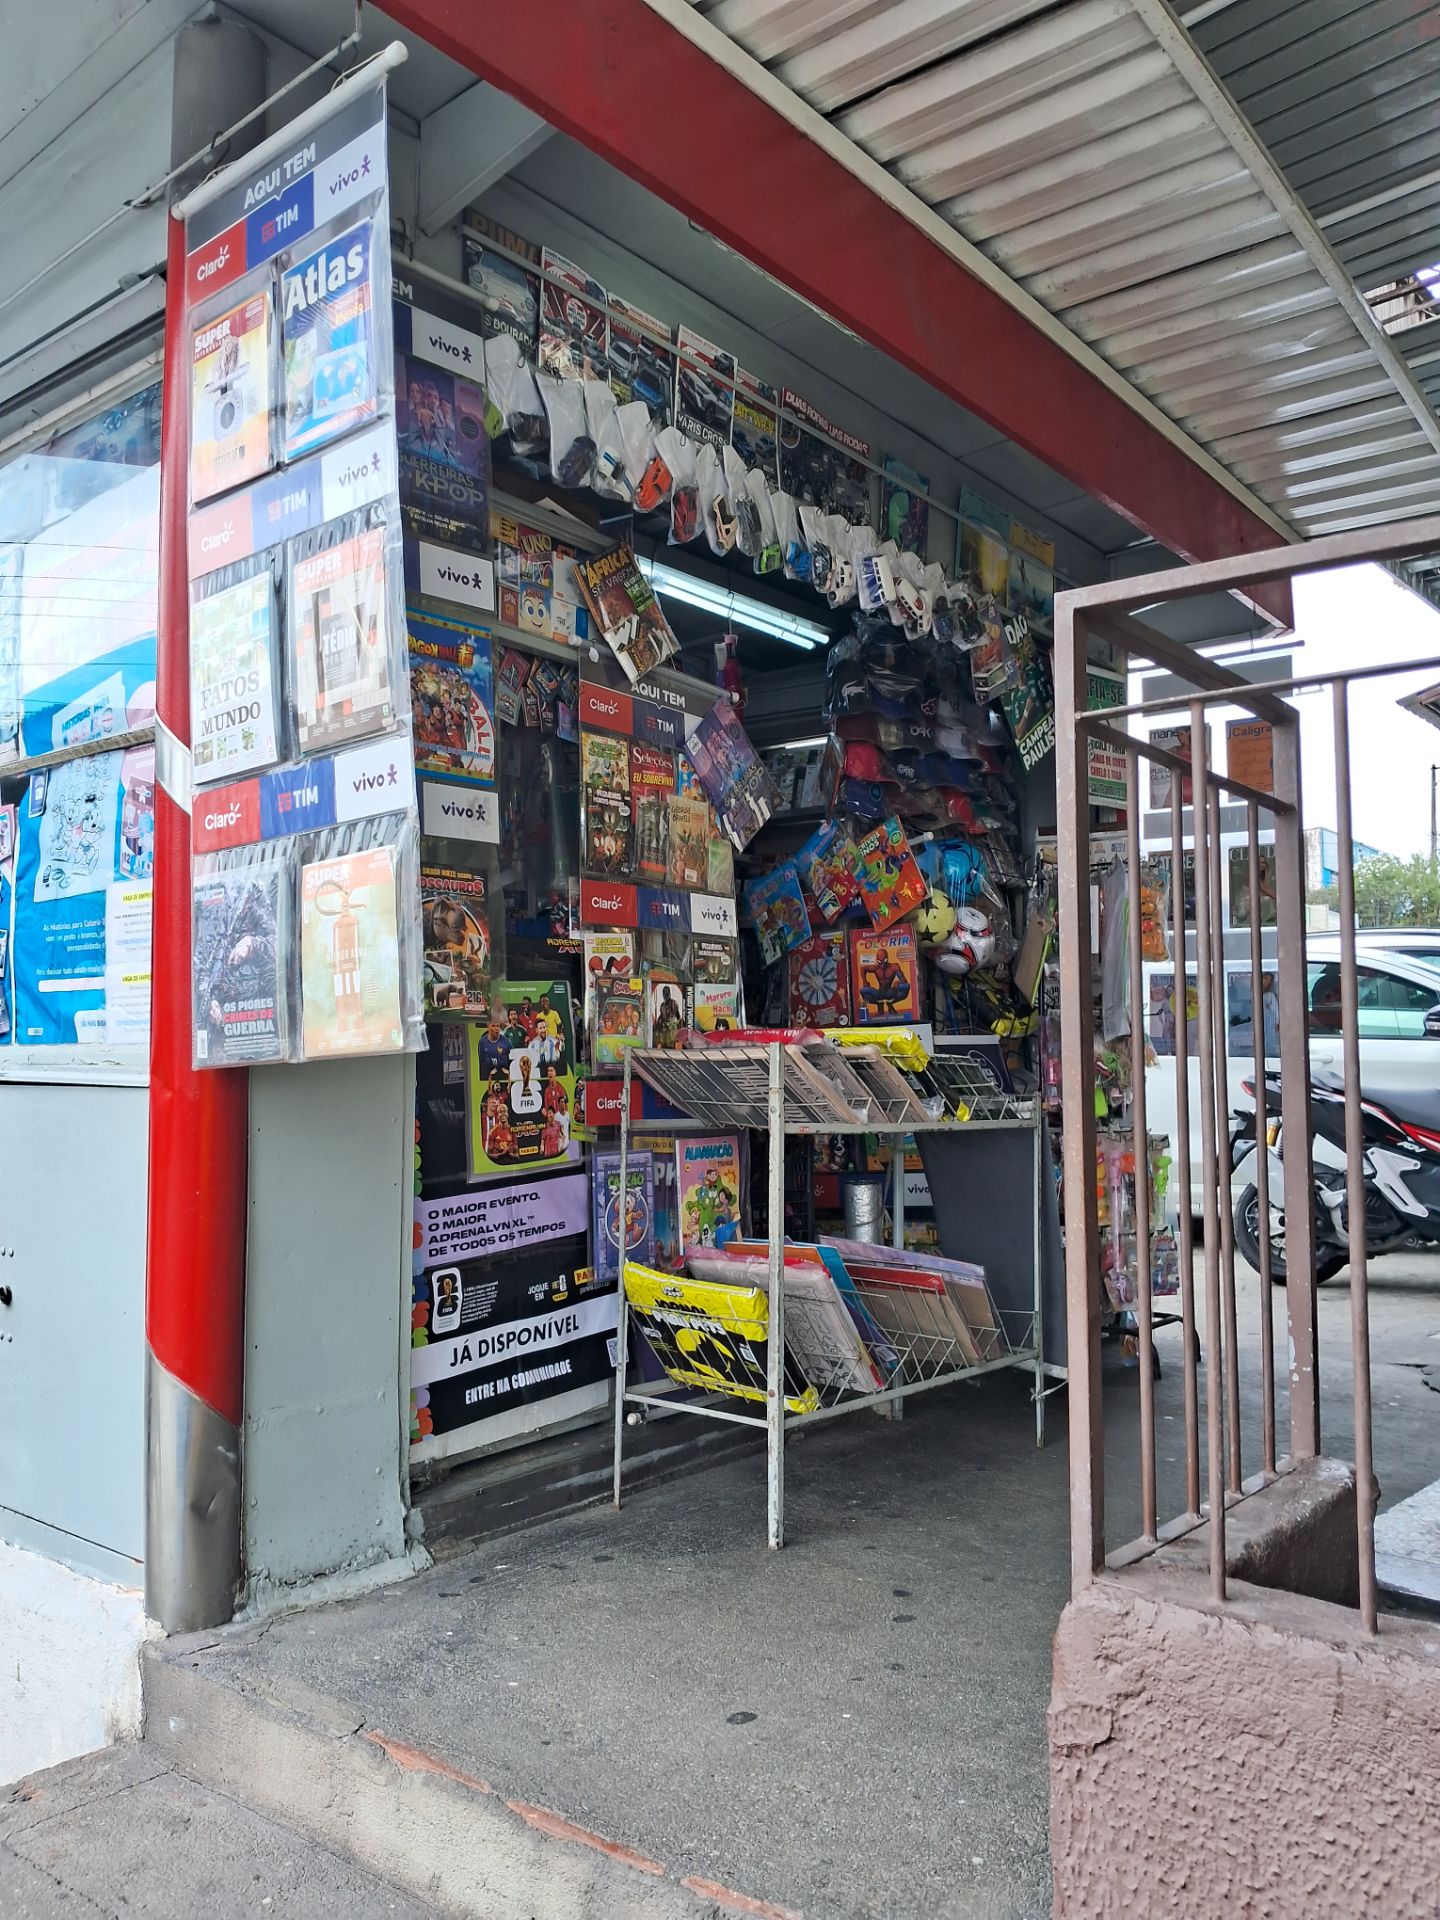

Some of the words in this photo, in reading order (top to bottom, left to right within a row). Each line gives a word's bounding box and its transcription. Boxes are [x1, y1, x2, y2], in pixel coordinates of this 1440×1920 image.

[244, 167, 281, 210] AQUI
[283, 142, 316, 180] TEM
[329, 168, 359, 196] vivo
[275, 204, 299, 233] TIM
[197, 253, 225, 281] Claro
[285, 243, 364, 319] Atlas
[194, 319, 231, 353] SUPER
[428, 336, 460, 357] vivo
[338, 465, 369, 488] vivo
[282, 487, 307, 514] TIM
[200, 525, 229, 553] Claro
[520, 535, 552, 556] UNO
[299, 551, 342, 581] SUPER
[437, 567, 470, 586] vivo
[200, 671, 260, 712] FATOS
[631, 682, 660, 700] AQUI
[662, 690, 686, 708] TEM
[589, 698, 615, 715] Claro
[200, 700, 261, 738] MUNDO
[656, 718, 674, 734] TIM
[633, 747, 673, 770] Seleções
[352, 771, 385, 794] vivo
[292, 785, 319, 809] TIM
[204, 808, 236, 832] Claro
[442, 802, 473, 819] vivo
[591, 896, 618, 910] Claro
[662, 903, 680, 916] TIM
[701, 908, 721, 921] vivo
[223, 1001, 236, 1015] OS
[238, 998, 273, 1011] PIORES
[467, 990, 483, 1003] 216
[223, 1008, 259, 1024] CRIMES
[261, 1008, 273, 1021] DE
[223, 1019, 275, 1037] GUERRA
[520, 1100, 536, 1108] FIFA
[1396, 1141, 1427, 1153] ADV
[428, 1210, 440, 1220] O
[442, 1202, 488, 1218] MAIOR
[489, 1191, 541, 1209] EVENTO.
[428, 1222, 440, 1232] O
[442, 1213, 487, 1230] MAIOR
[428, 1246, 448, 1258] DE
[450, 1236, 496, 1253] TODOS
[498, 1231, 516, 1243] OS
[519, 1221, 567, 1239] TEMPOS
[527, 1282, 549, 1295] JOGUE
[534, 1292, 545, 1302] EM
[450, 1339, 473, 1368] JÁ
[478, 1313, 580, 1359] DISPONÍVEL
[465, 1383, 495, 1405] ENTRE
[496, 1379, 510, 1393] NA
[511, 1359, 573, 1390] COMUNIDADE
